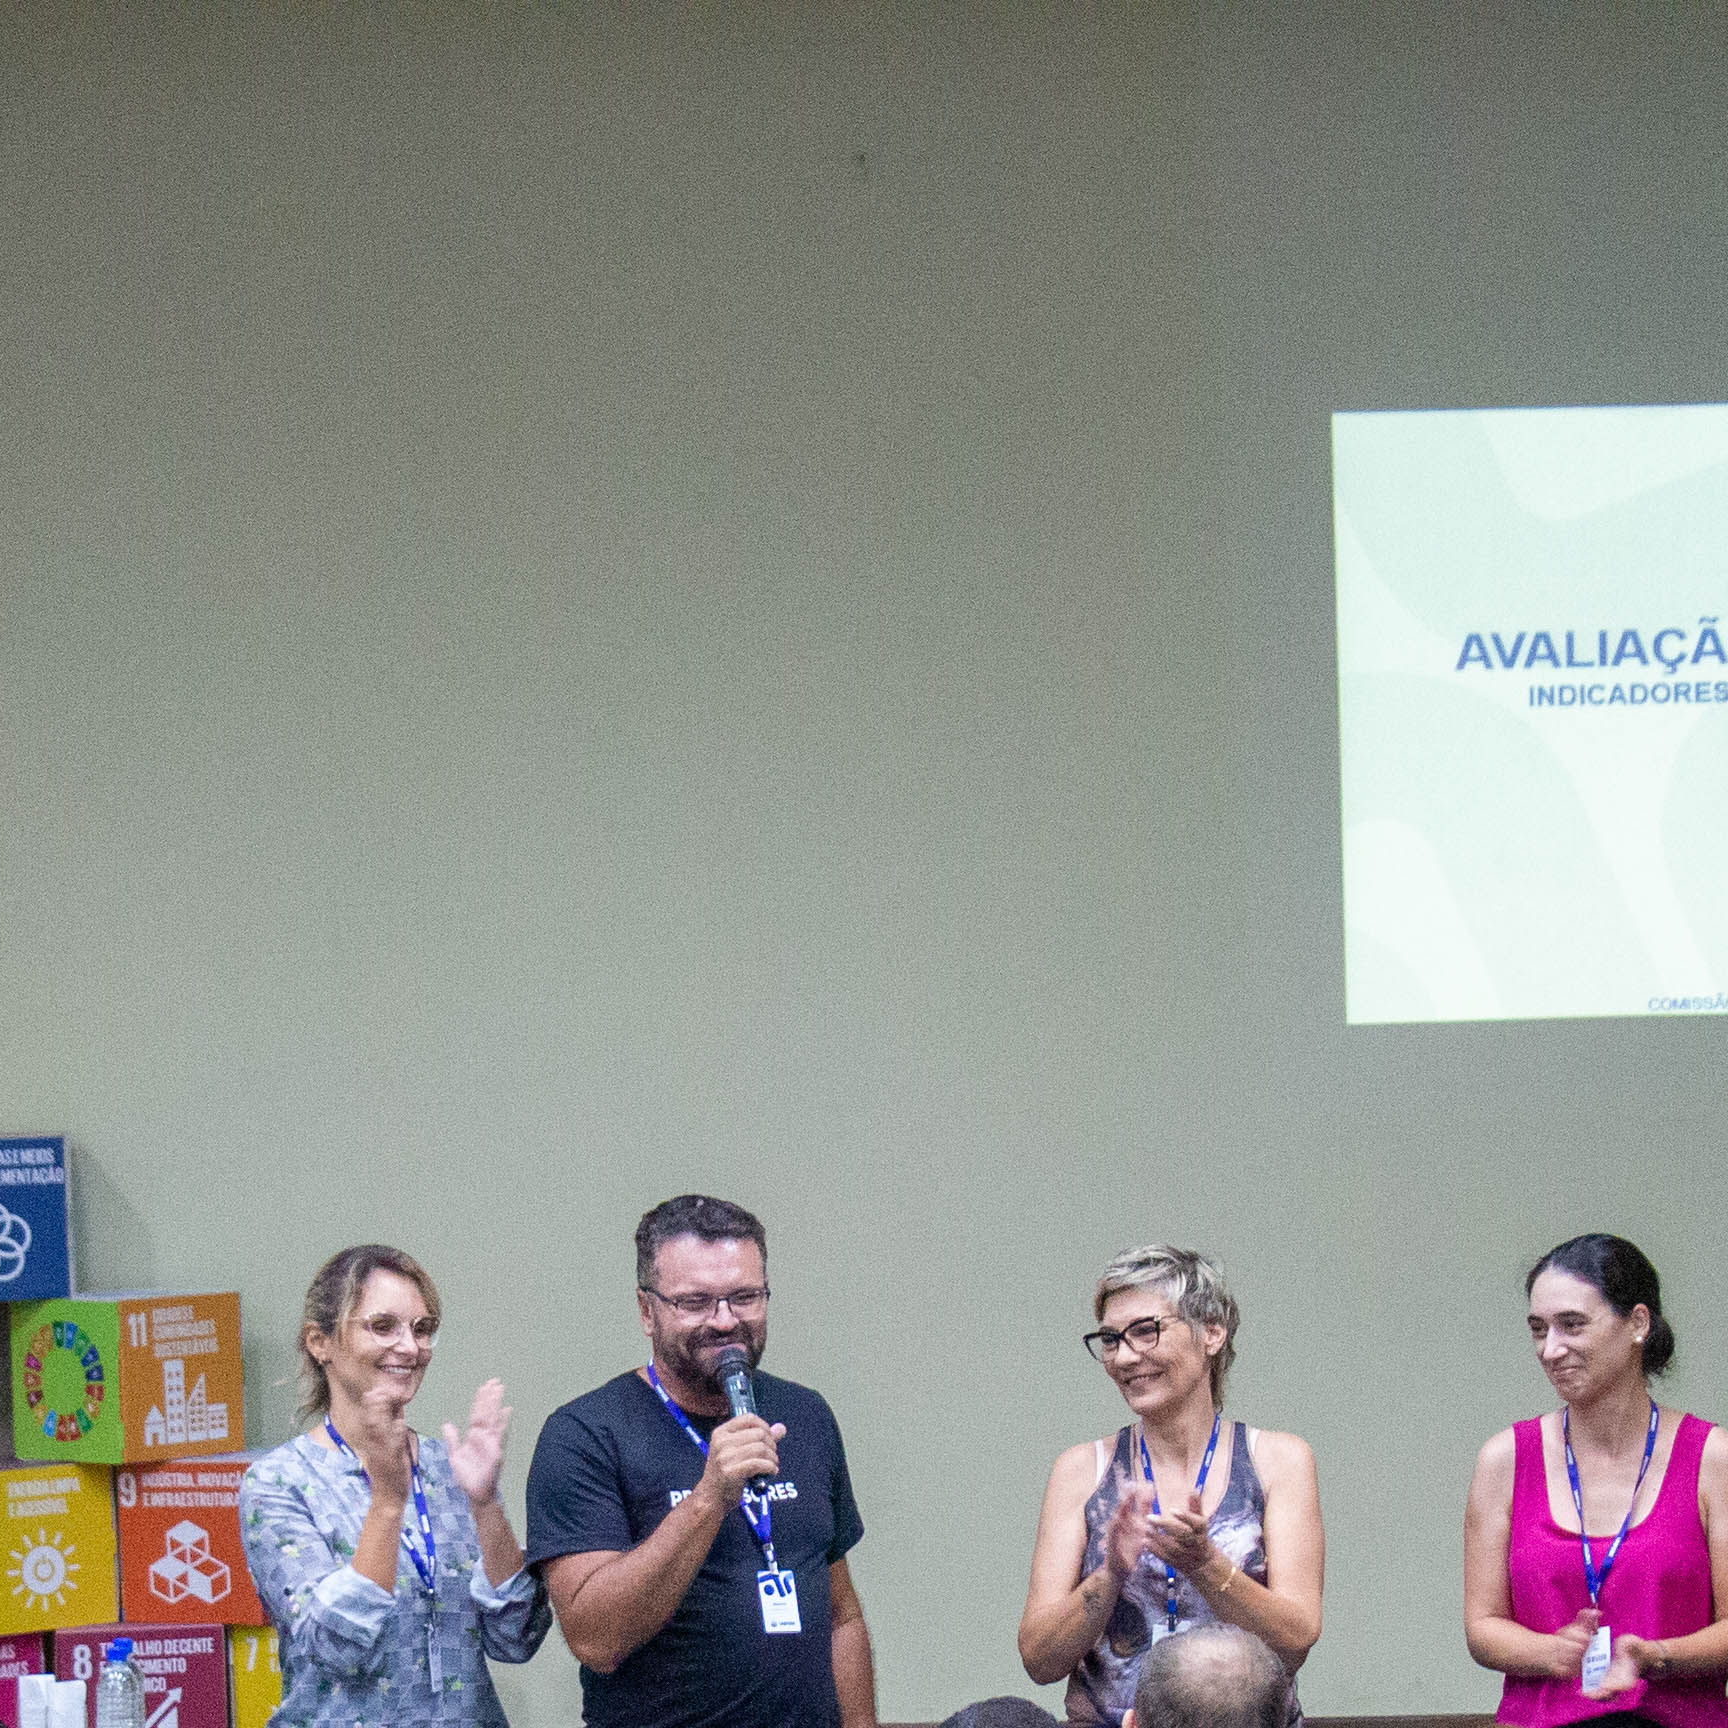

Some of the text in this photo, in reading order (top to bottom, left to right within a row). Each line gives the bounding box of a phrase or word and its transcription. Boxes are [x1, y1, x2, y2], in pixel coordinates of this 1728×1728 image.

[128, 1312, 147, 1347] 11
[119, 1472, 136, 1507] 9
[197, 1470, 241, 1488] INOVAÇÃ
[73, 1644, 92, 1680] 8
[99, 1637, 215, 1658] TALHO DECENTE
[245, 1637, 258, 1672] 7
